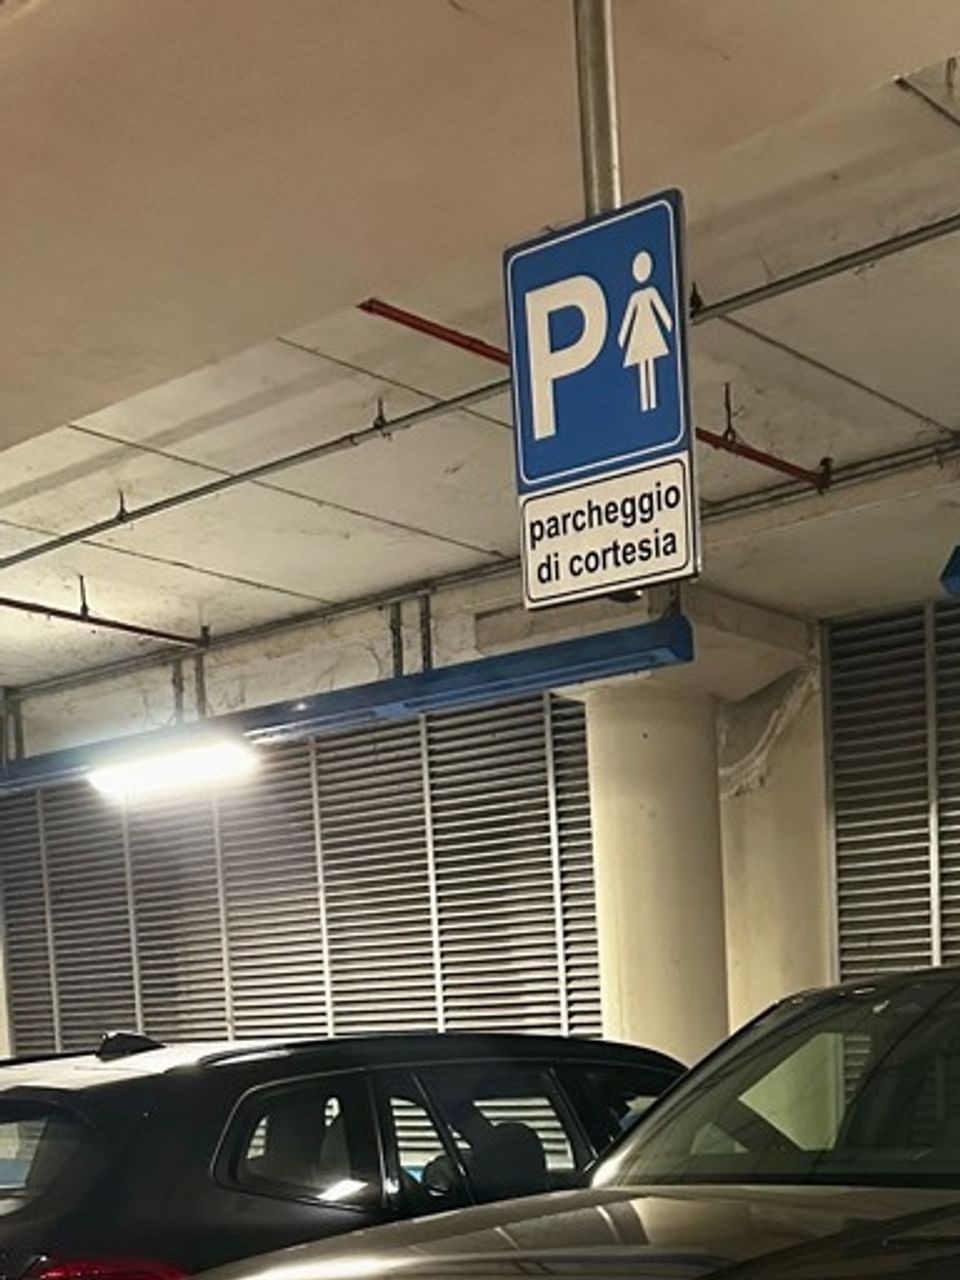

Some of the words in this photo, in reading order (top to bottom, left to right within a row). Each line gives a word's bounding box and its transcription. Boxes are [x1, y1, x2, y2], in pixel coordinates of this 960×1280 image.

[525, 274, 609, 441] P
[529, 482, 681, 548] parcheggio
[537, 552, 560, 584] di
[569, 528, 678, 579] cortesia
